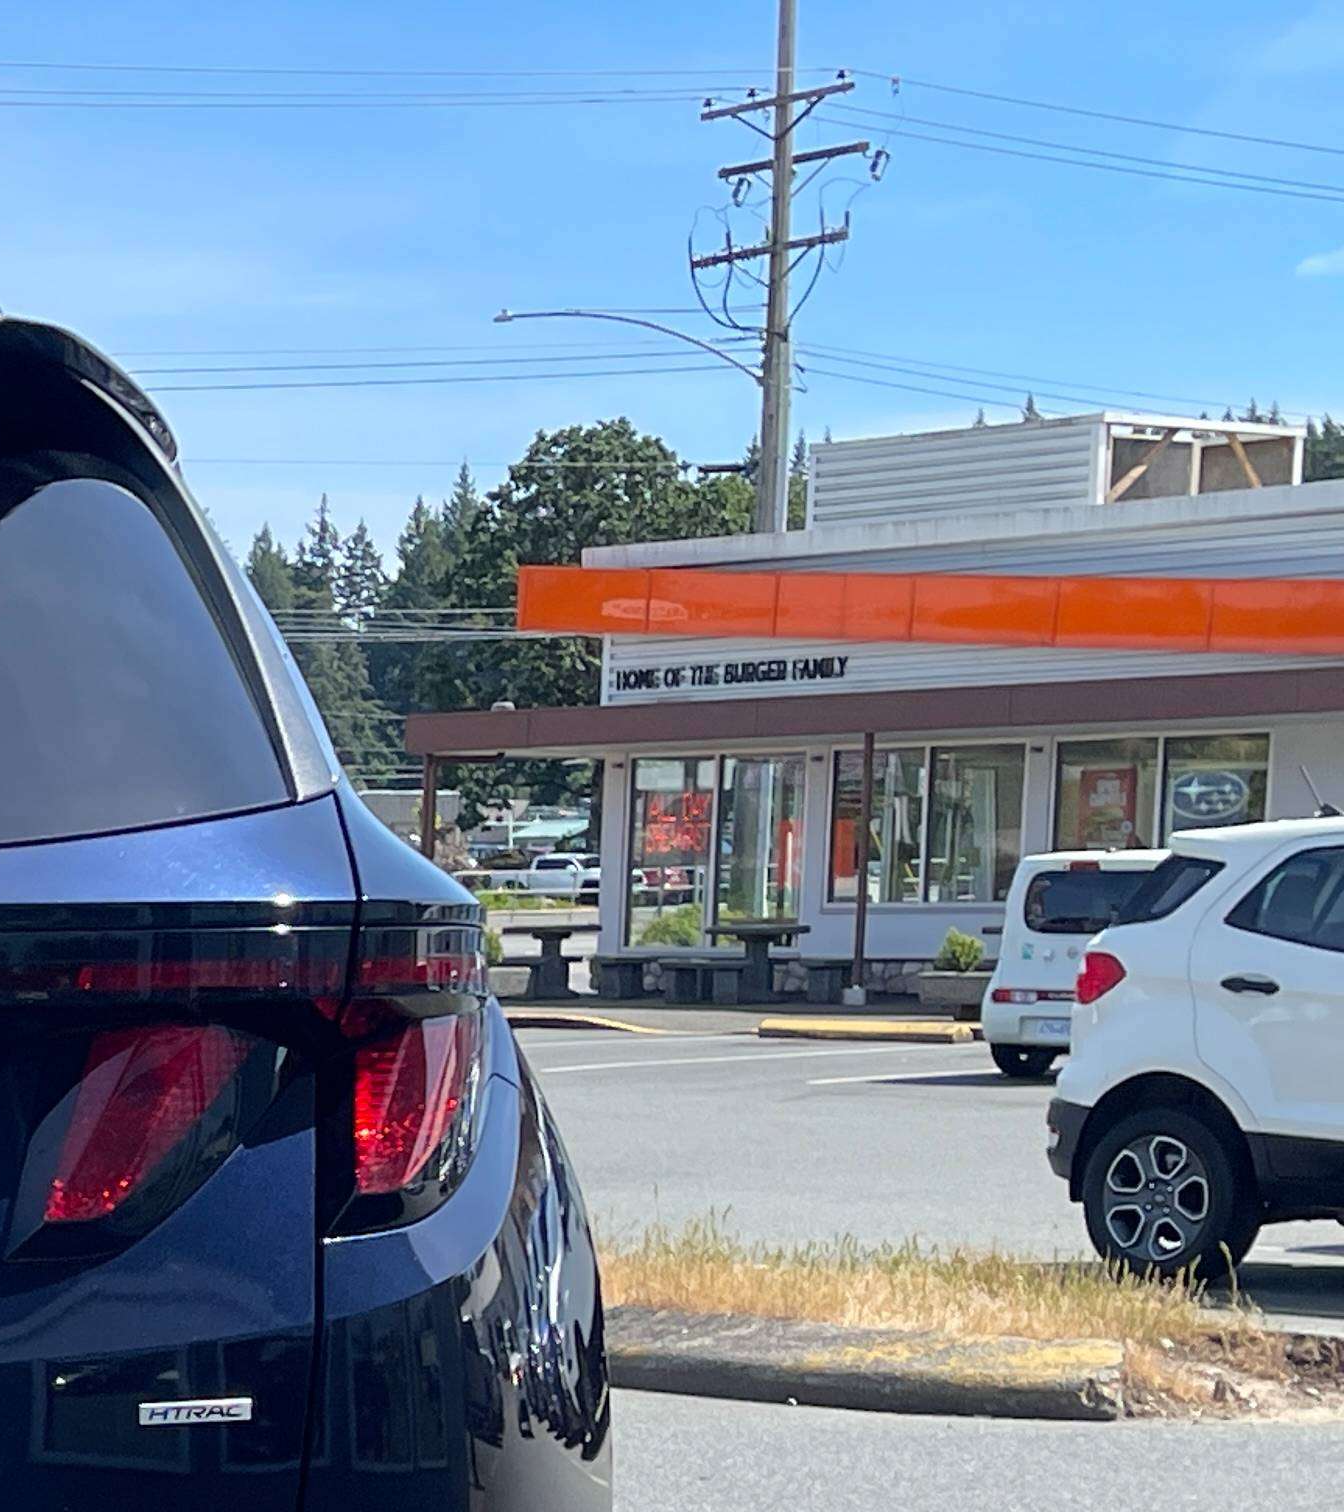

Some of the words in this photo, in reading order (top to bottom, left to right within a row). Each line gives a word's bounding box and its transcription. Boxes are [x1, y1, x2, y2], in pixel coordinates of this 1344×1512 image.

[616, 666, 660, 690] HOME
[664, 665, 686, 688] OF
[690, 663, 720, 687] THE
[723, 659, 787, 684] BURGER
[792, 656, 849, 681] FAMILY
[147, 1403, 244, 1421] HTRAC
